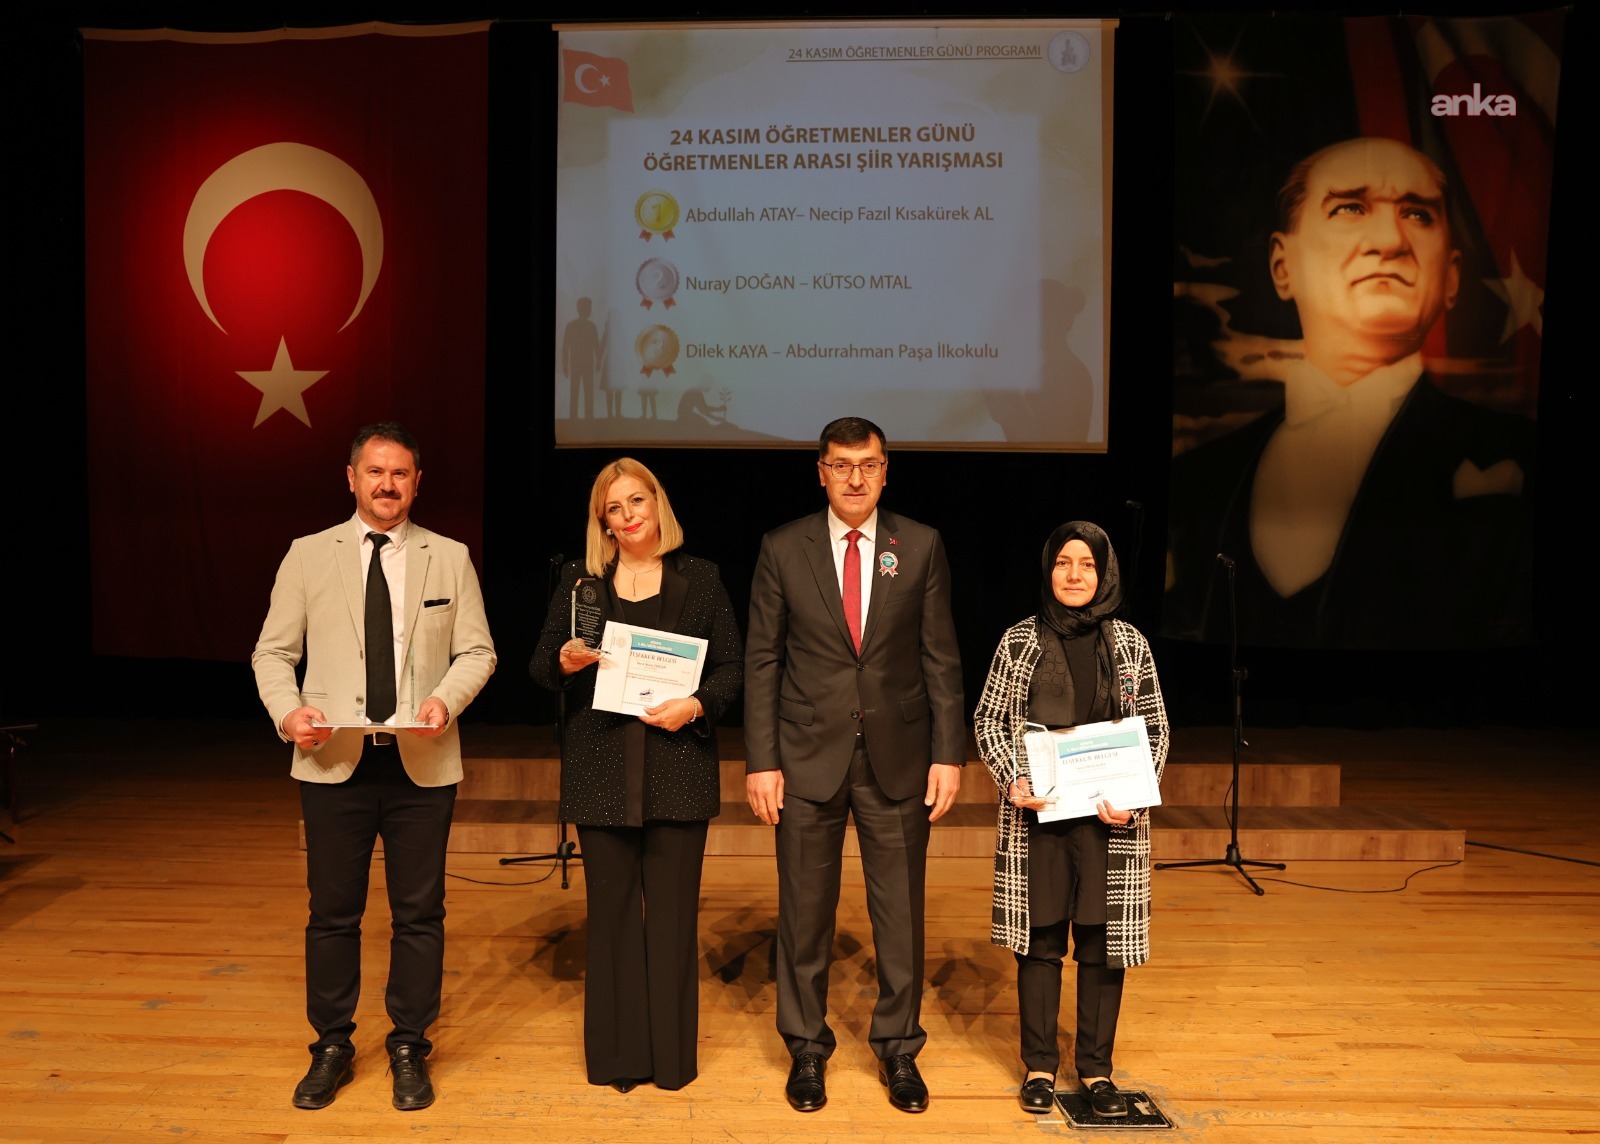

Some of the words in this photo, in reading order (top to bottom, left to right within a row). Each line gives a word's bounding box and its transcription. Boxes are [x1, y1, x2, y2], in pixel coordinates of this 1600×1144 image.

[788, 48, 802, 59] 24
[806, 48, 843, 58] KASIM
[846, 45, 934, 58] ÖĞRETMENLER
[937, 44, 973, 57] GÜNÜ
[976, 45, 1041, 56] PROGRAMI
[670, 130, 693, 145] 24
[699, 128, 760, 144] KASIM
[766, 125, 911, 144] ÖĞRETMENLER
[917, 123, 975, 143] GÜNÜ
[643, 151, 788, 172] ÖĞRETMENLER
[793, 153, 851, 170] ARASI
[857, 149, 893, 173] ŞİİR
[898, 151, 1003, 173] YARIŞMASI
[685, 206, 754, 222] Abdullah
[809, 206, 853, 225] Necip
[858, 205, 890, 221] Fazıl
[896, 204, 969, 221] Kısakürek
[974, 205, 994, 221] AL
[686, 275, 731, 295] Nuray
[736, 272, 795, 290] DOĞAN
[813, 272, 865, 290] KÜTSO
[870, 275, 912, 290] MTAL
[686, 343, 724, 359] Dilek
[729, 344, 768, 359] KAYA
[786, 343, 893, 359] Abdurrahman
[899, 344, 932, 362] Paşa
[938, 341, 999, 359] İlkokulu
